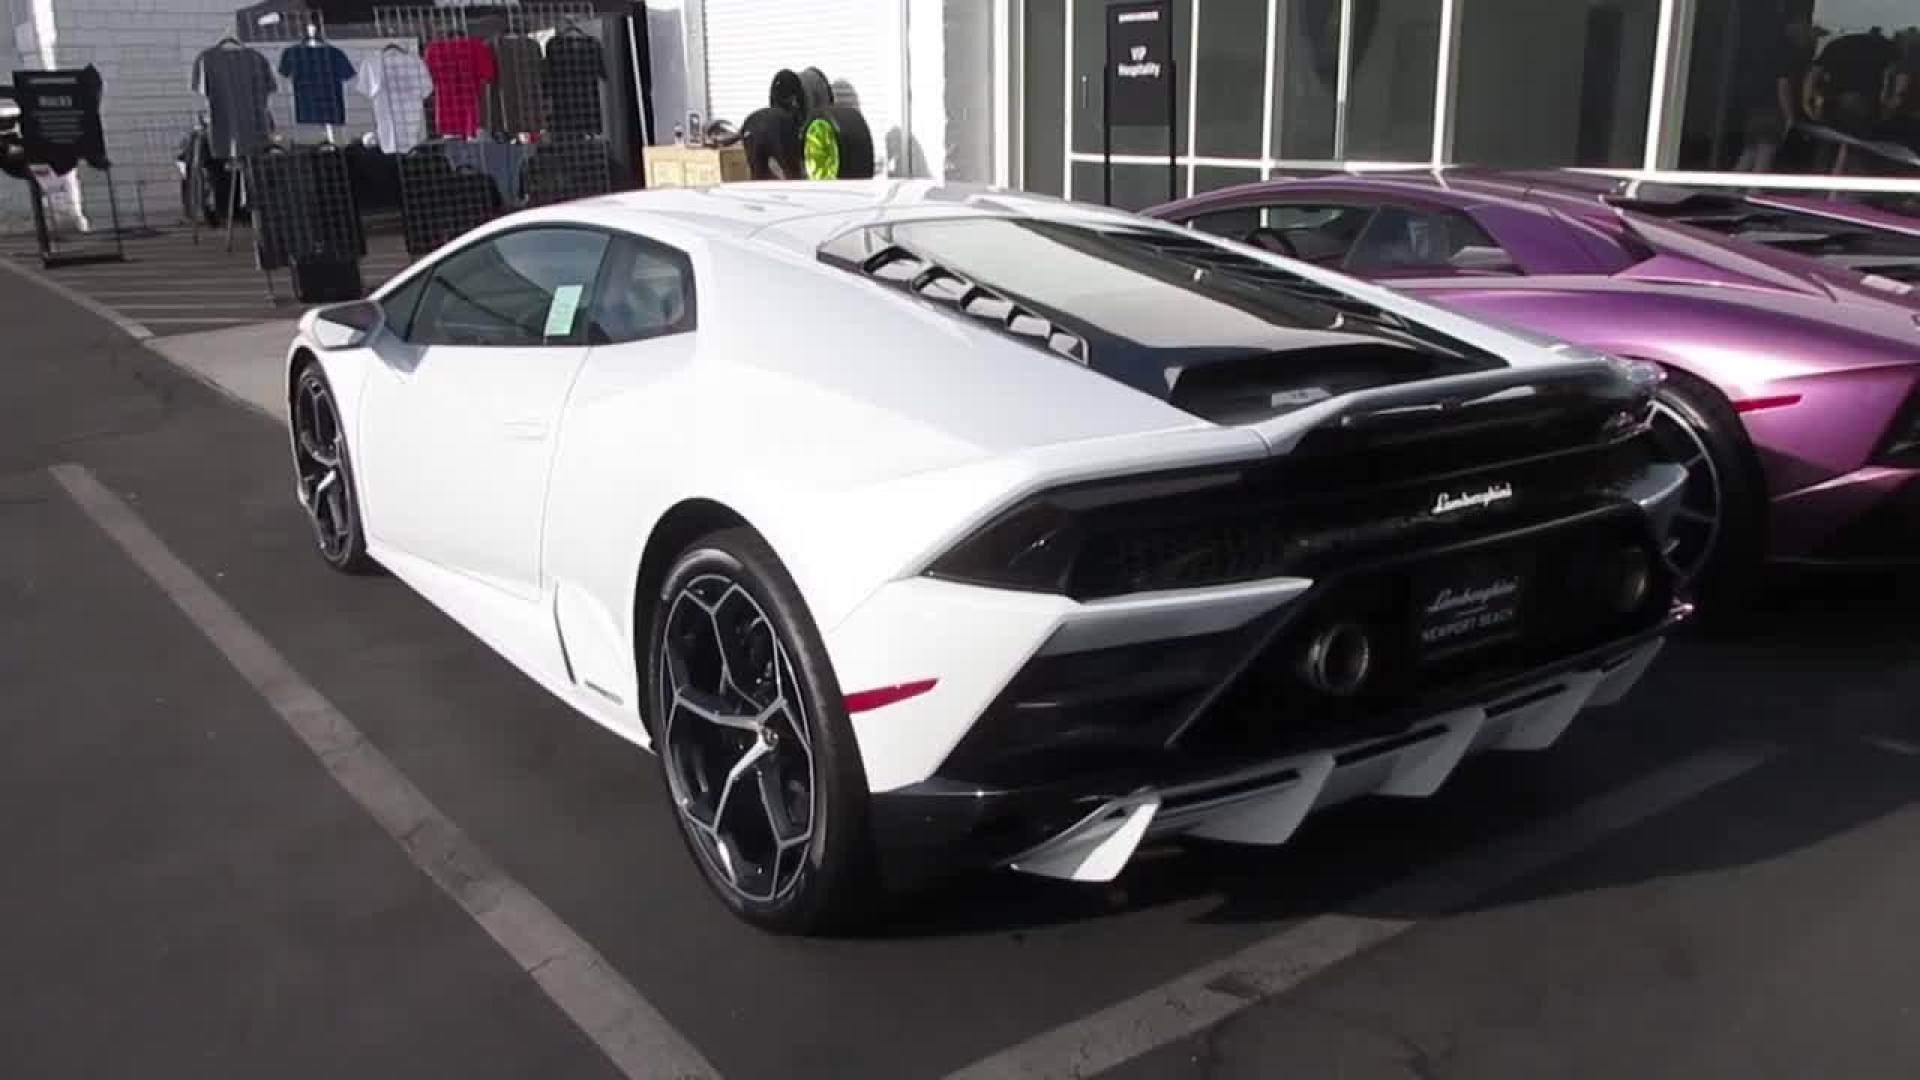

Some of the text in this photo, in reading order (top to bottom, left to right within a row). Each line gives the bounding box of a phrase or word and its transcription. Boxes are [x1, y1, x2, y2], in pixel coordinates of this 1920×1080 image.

[1130, 46, 1147, 61] VIP
[1118, 62, 1160, 78] Hospitality
[1431, 482, 1513, 514] Lamborghini
[1427, 577, 1519, 613] Lamborghini
[1421, 615, 1477, 642] NEWPORT
[1478, 608, 1517, 629] BEACH
